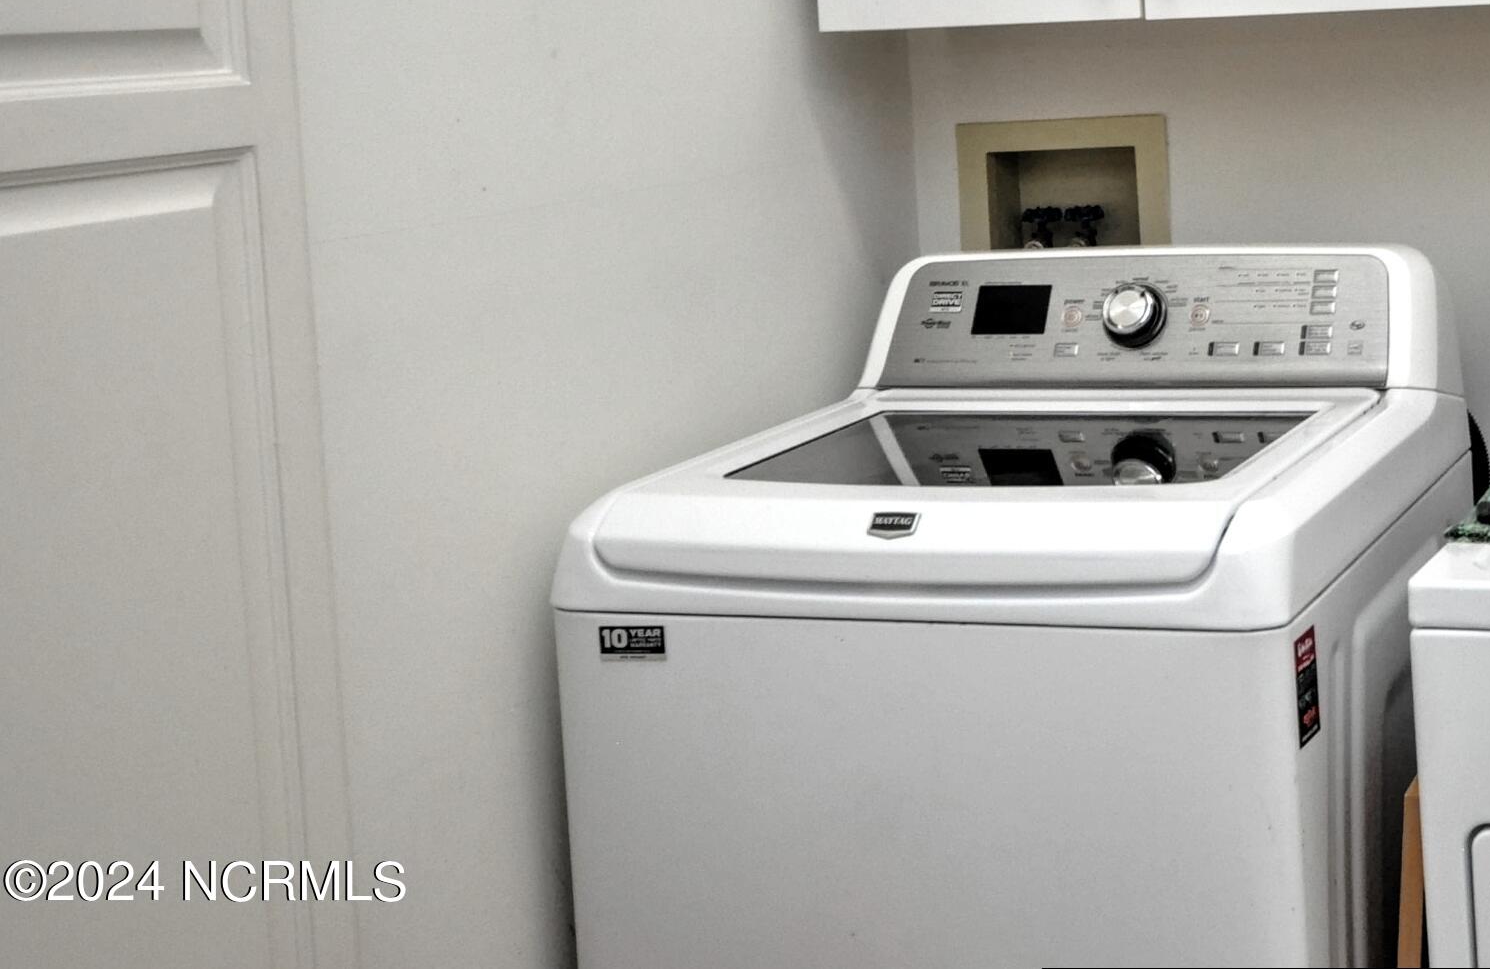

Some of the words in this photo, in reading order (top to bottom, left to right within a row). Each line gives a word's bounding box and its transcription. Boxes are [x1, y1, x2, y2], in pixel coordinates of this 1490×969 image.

[874, 517, 914, 526] MAYTAG
[601, 628, 628, 649] 10
[629, 628, 662, 637] YEAR
